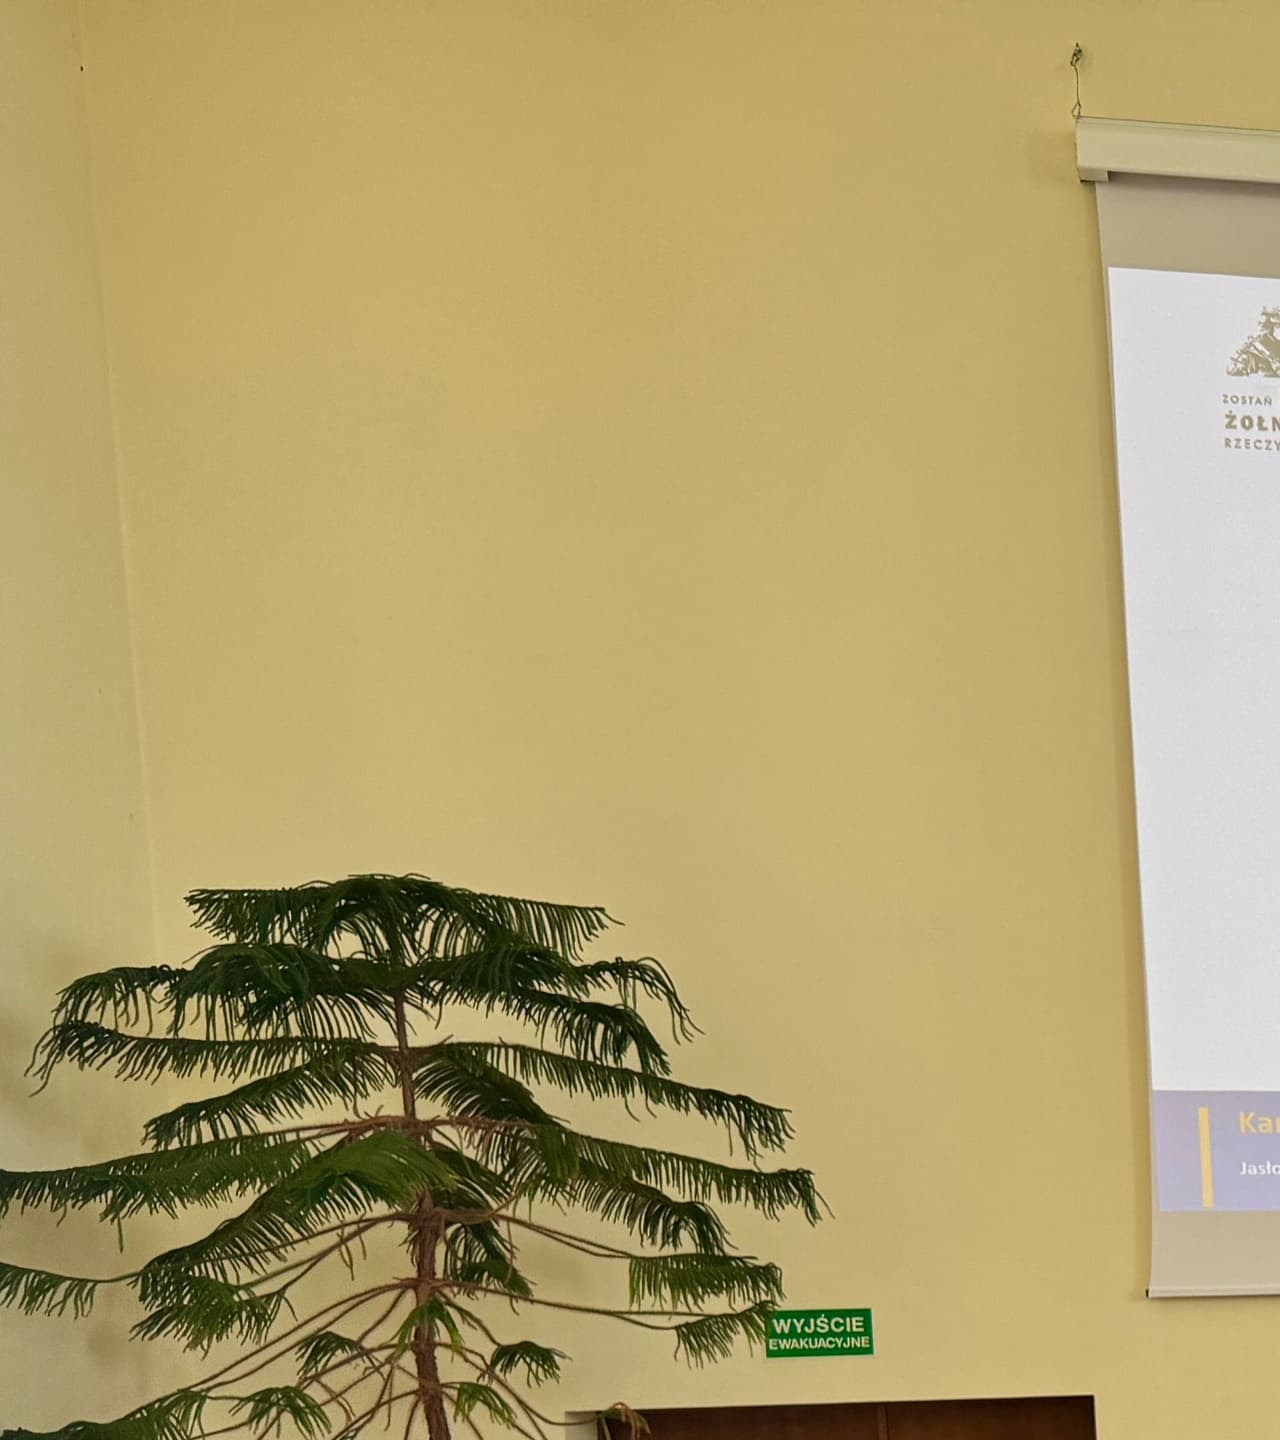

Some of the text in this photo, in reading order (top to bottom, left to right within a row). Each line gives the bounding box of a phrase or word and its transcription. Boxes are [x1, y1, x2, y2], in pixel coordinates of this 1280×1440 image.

[1222, 393, 1273, 407] ZOSTAŃ
[771, 1313, 865, 1335] WYJŚCIE
[768, 1336, 871, 1351] EWAKUACYJNE
